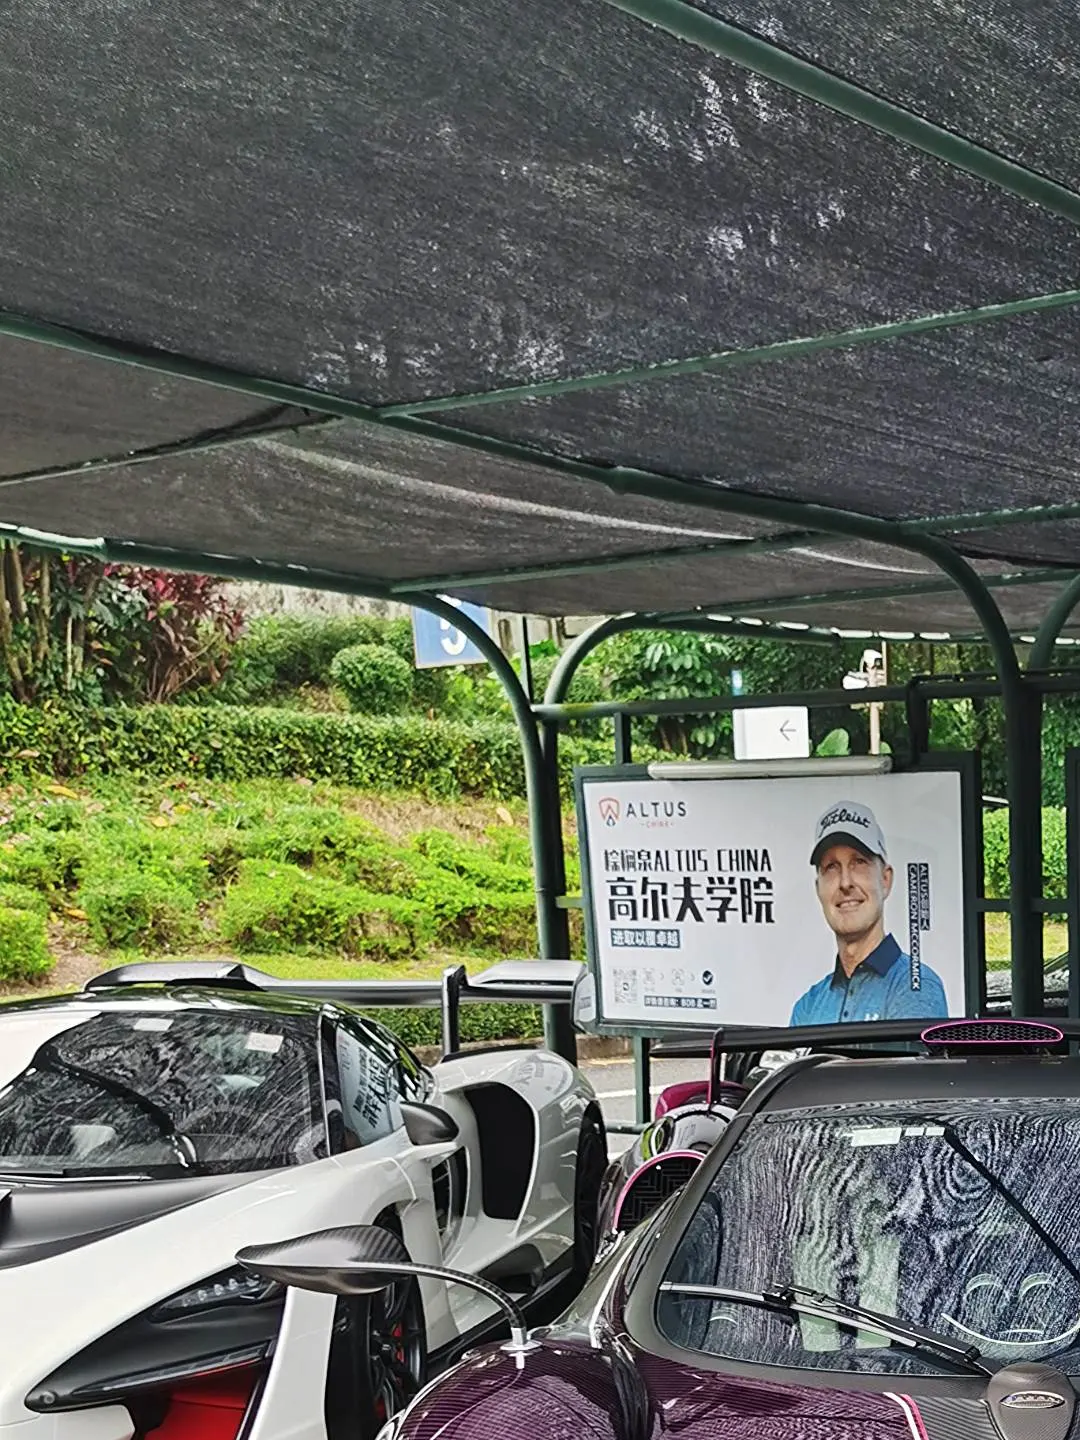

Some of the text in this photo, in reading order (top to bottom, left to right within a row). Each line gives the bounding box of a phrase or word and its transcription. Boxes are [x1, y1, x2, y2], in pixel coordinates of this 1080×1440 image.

[626, 801, 687, 817] ALTUS
[717, 849, 772, 872] CHINA
[606, 876, 775, 924] 高尔夫学院
[909, 864, 921, 990] CAMERON MCCORMICK
